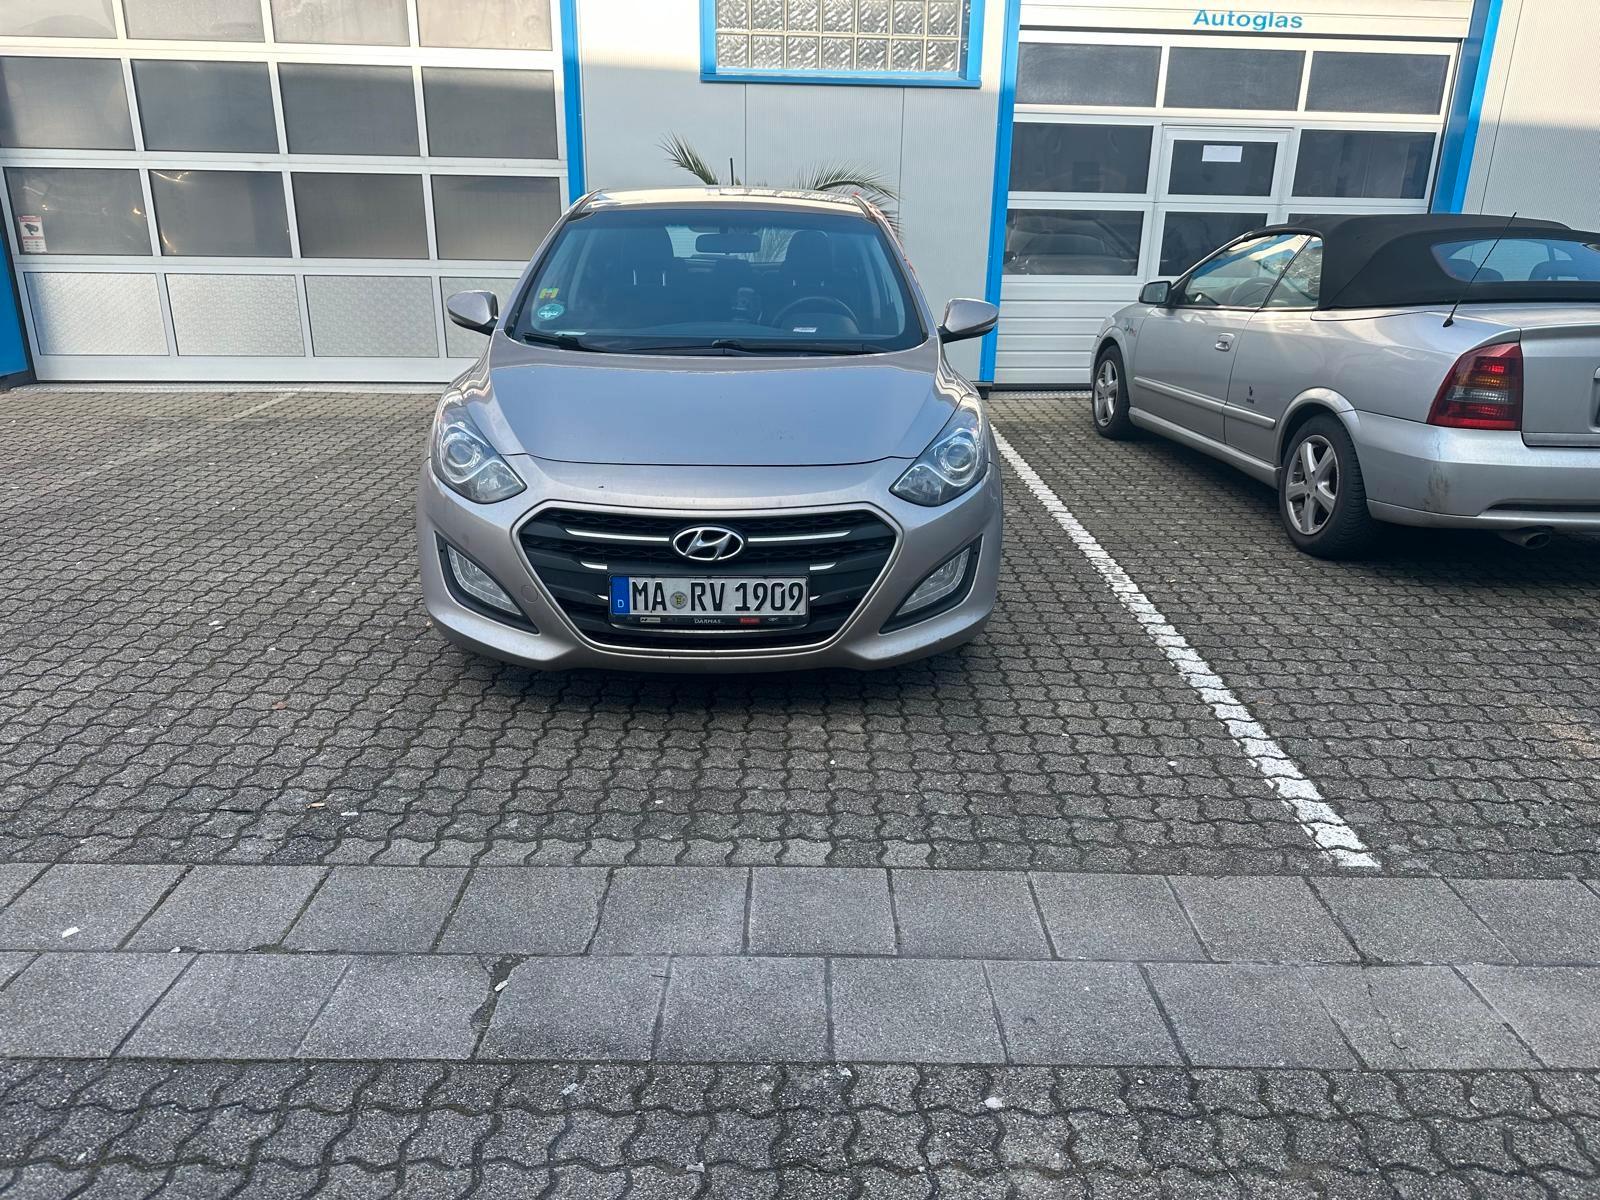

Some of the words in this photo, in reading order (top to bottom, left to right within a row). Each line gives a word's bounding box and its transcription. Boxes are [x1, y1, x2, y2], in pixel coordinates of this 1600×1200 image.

[1193, 10, 1303, 31] Autoglas
[617, 599, 625, 608] D
[632, 581, 667, 611] MA
[690, 582, 725, 611] RV
[734, 582, 804, 611] 1909
